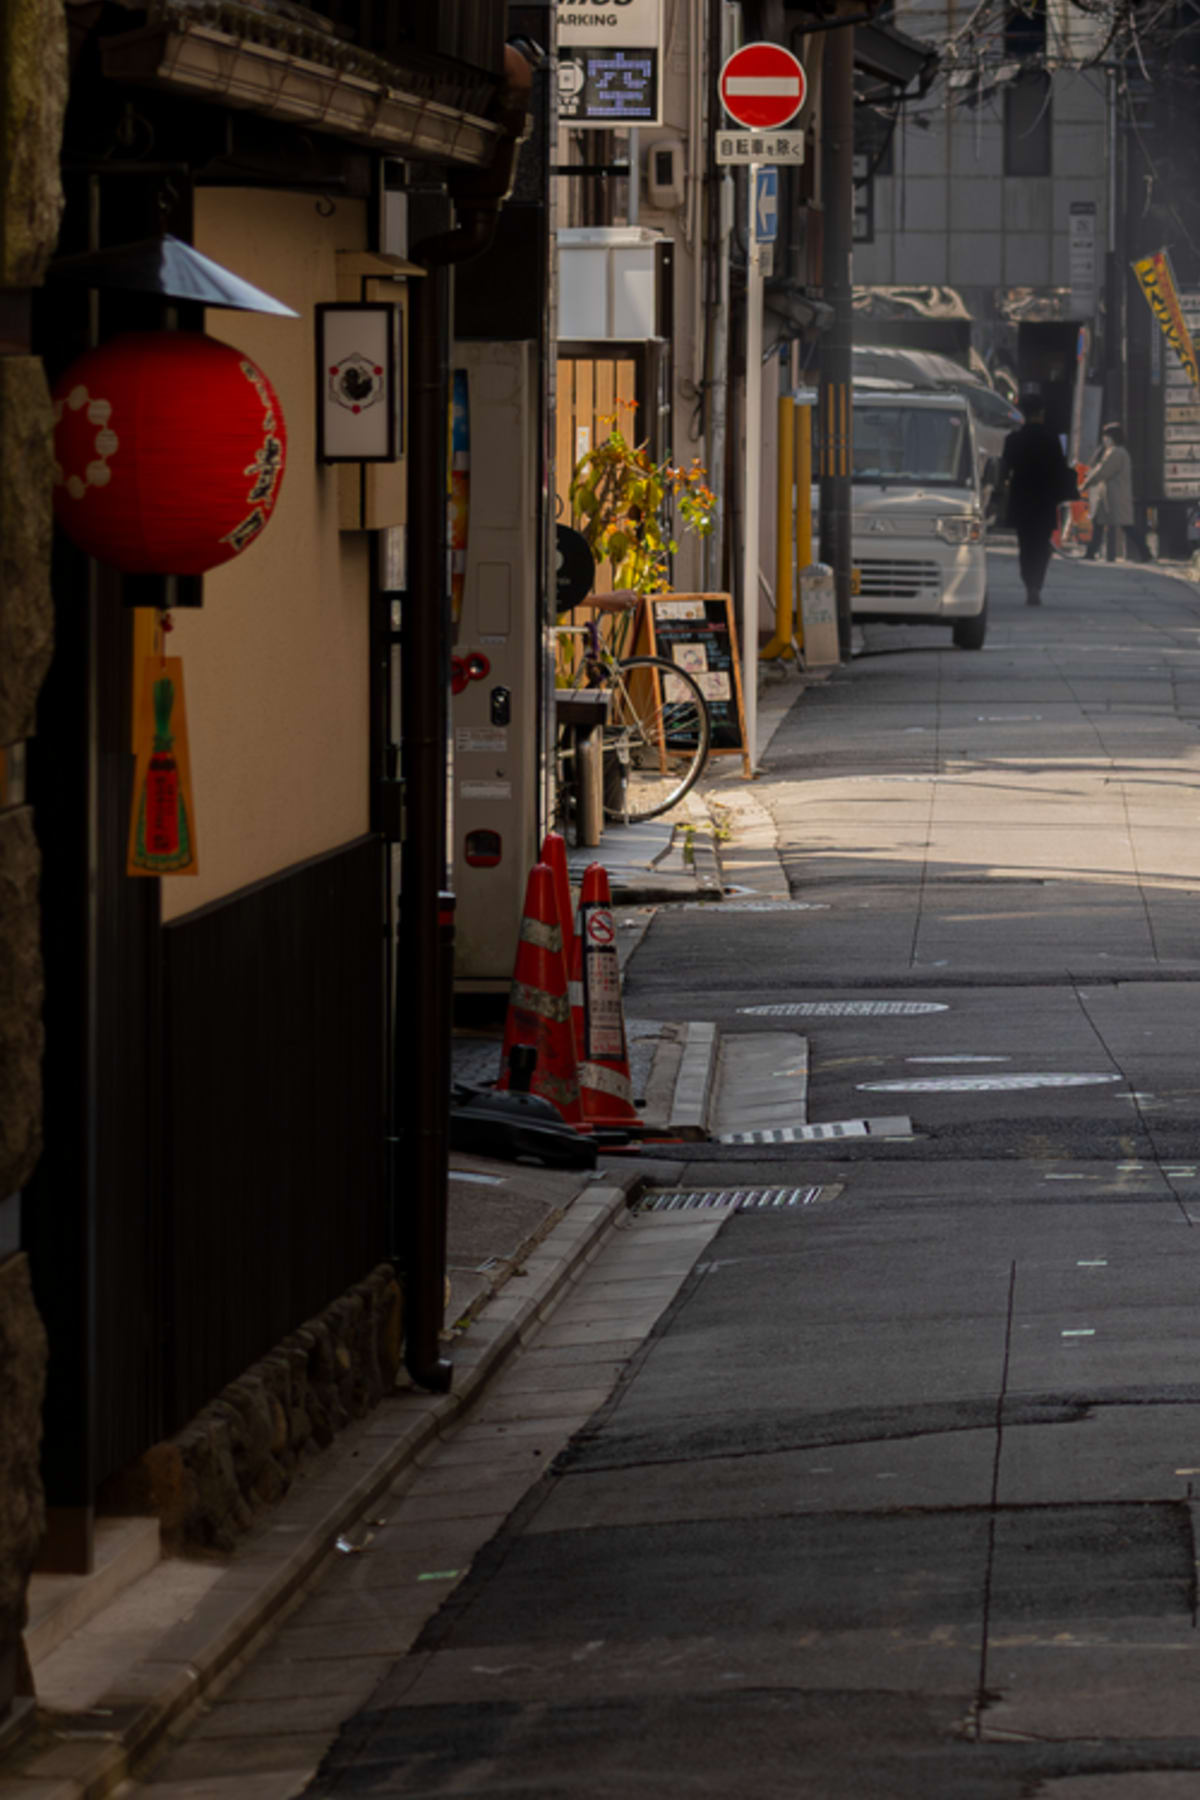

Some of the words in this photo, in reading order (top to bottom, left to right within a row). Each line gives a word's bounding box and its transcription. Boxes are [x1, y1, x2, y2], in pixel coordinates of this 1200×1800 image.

[587, 52, 652, 117] 空
[720, 137, 801, 157] 自転車を除く
